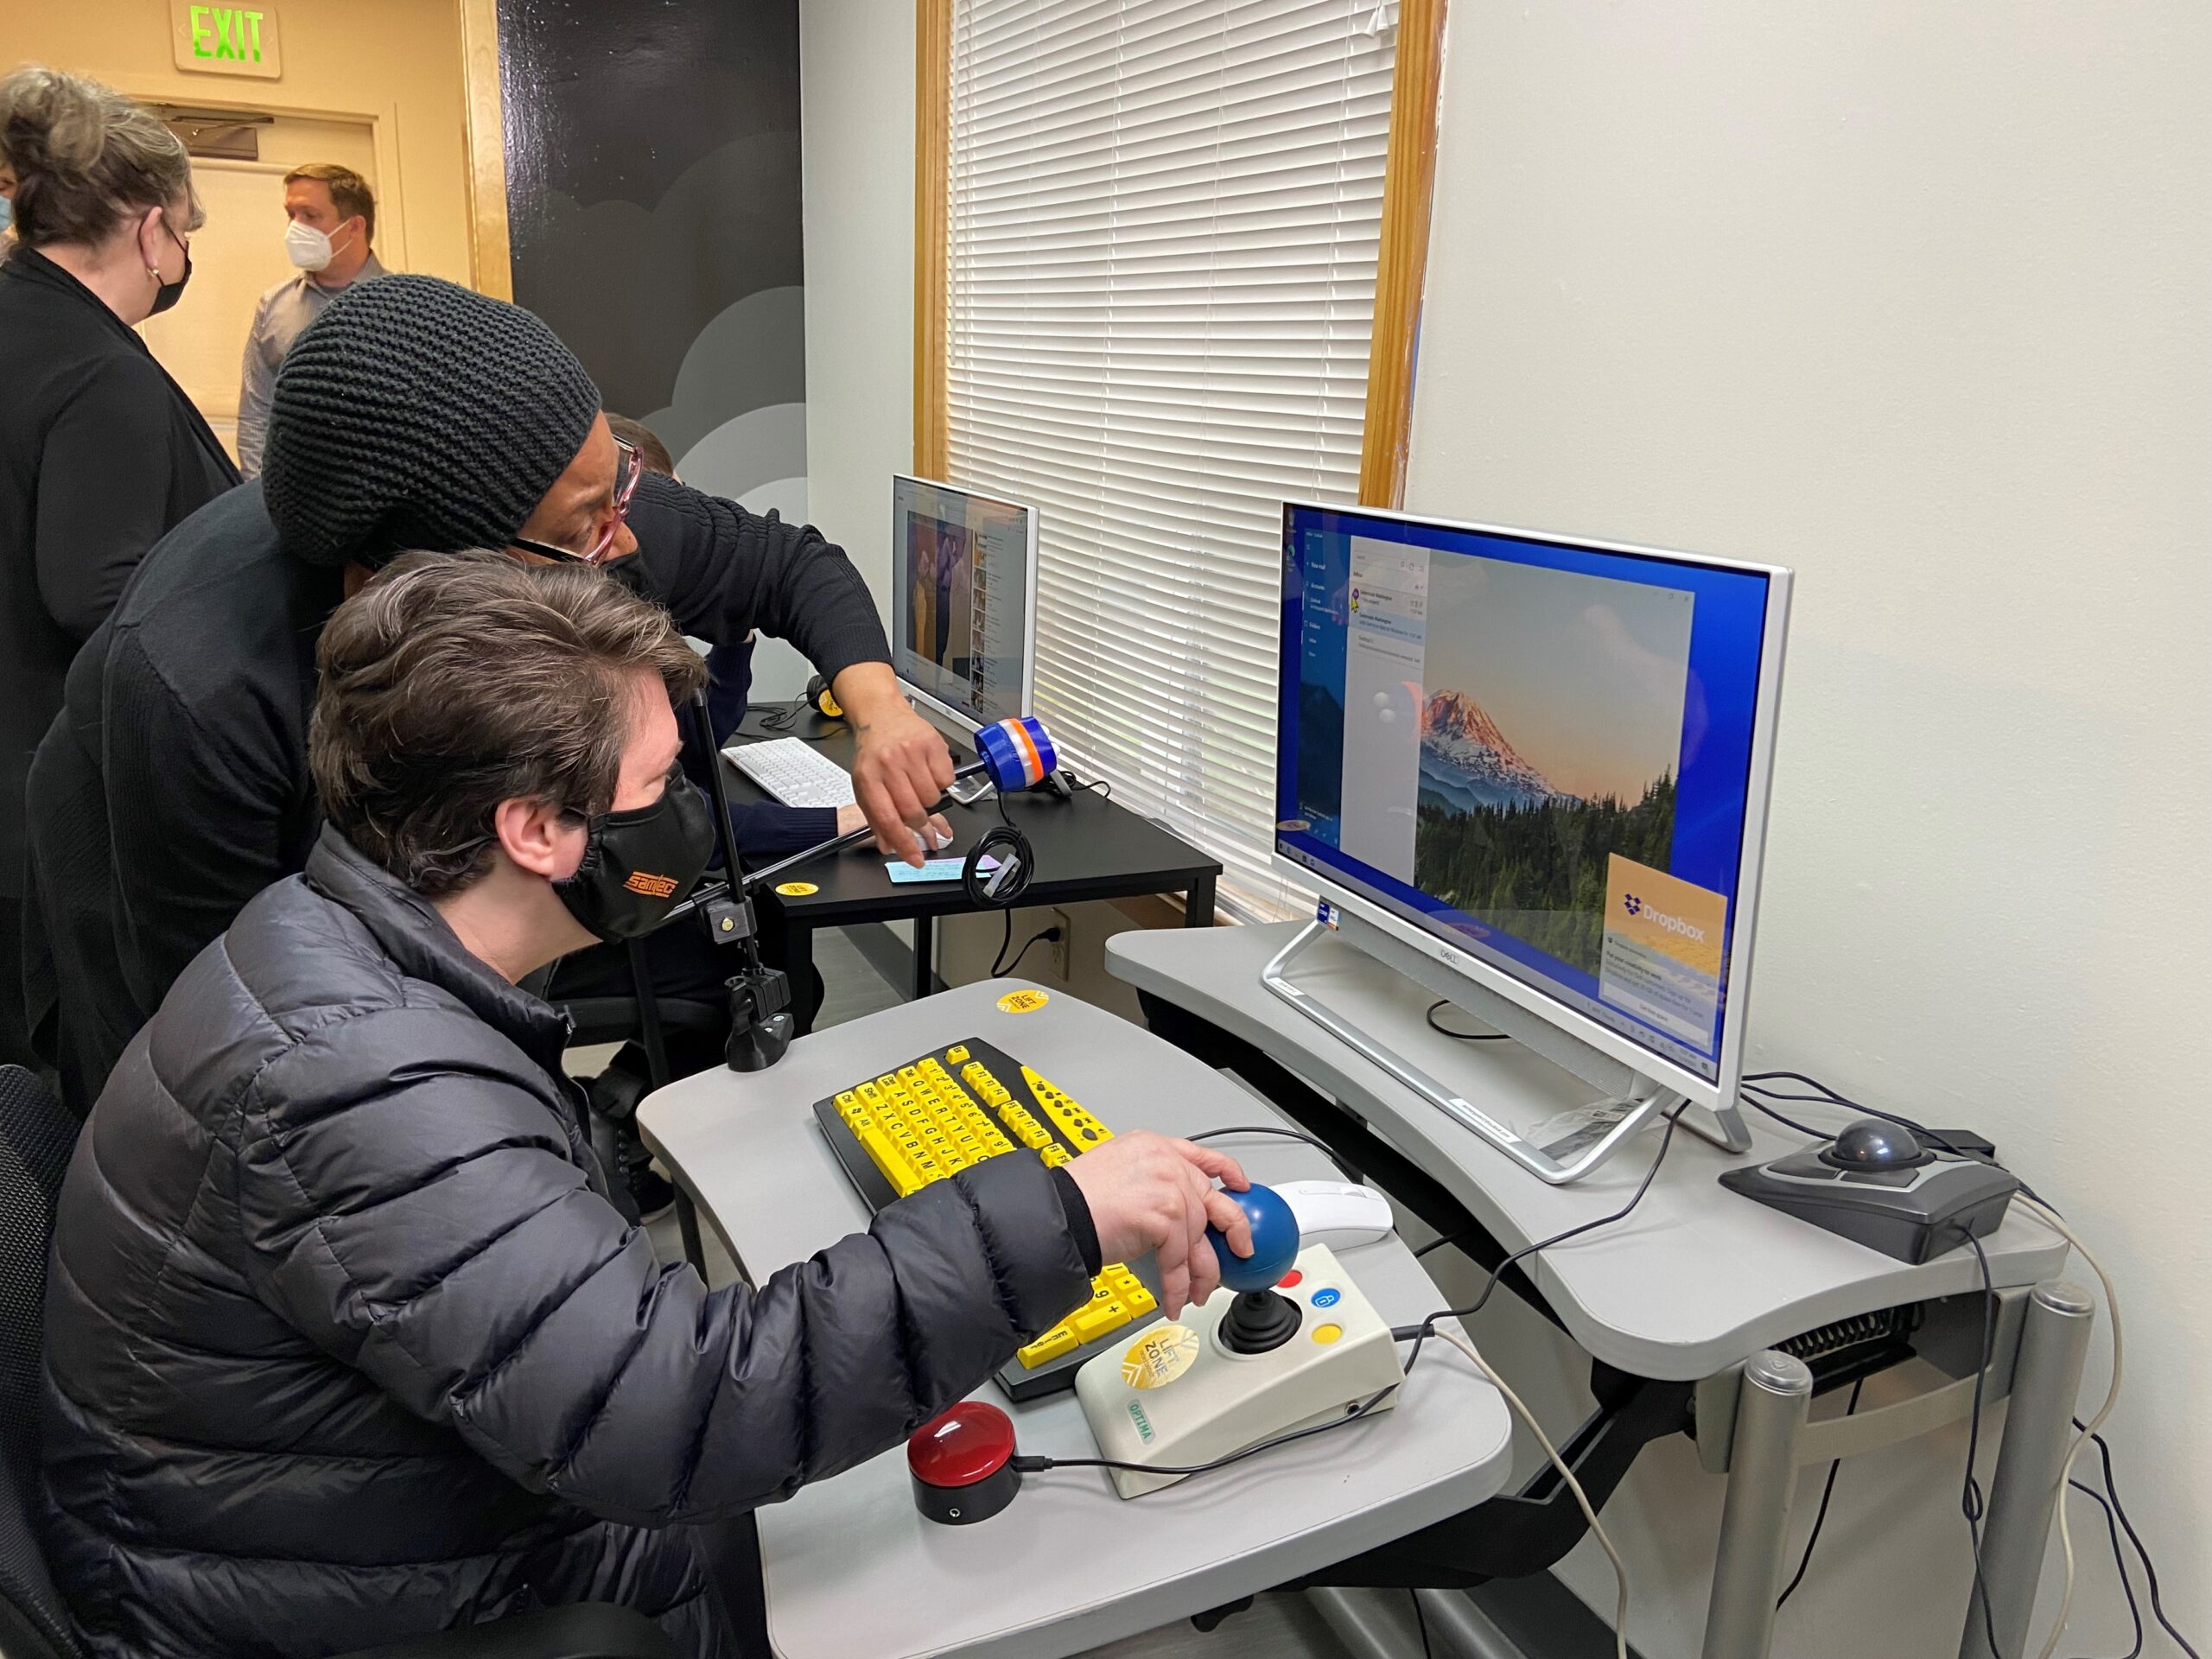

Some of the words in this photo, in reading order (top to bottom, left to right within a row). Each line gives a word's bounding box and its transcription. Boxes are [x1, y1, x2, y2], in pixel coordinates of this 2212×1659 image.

[190, 5, 263, 63] EXIT
[1643, 904, 1706, 943] Dropbox
[1440, 950, 1458, 964] DELL
[1012, 995, 1030, 1009] ZONE
[1021, 995, 1037, 1005] LIFT
[864, 1087, 878, 1099] Shift
[921, 1160, 937, 1169] M
[1095, 1290, 1109, 1299] 9
[1030, 1330, 1068, 1350] Enter
[1160, 1338, 1180, 1363] LIFT
[1145, 1341, 1167, 1378] ZONE
[1129, 1404, 1153, 1440] OPTIMA
